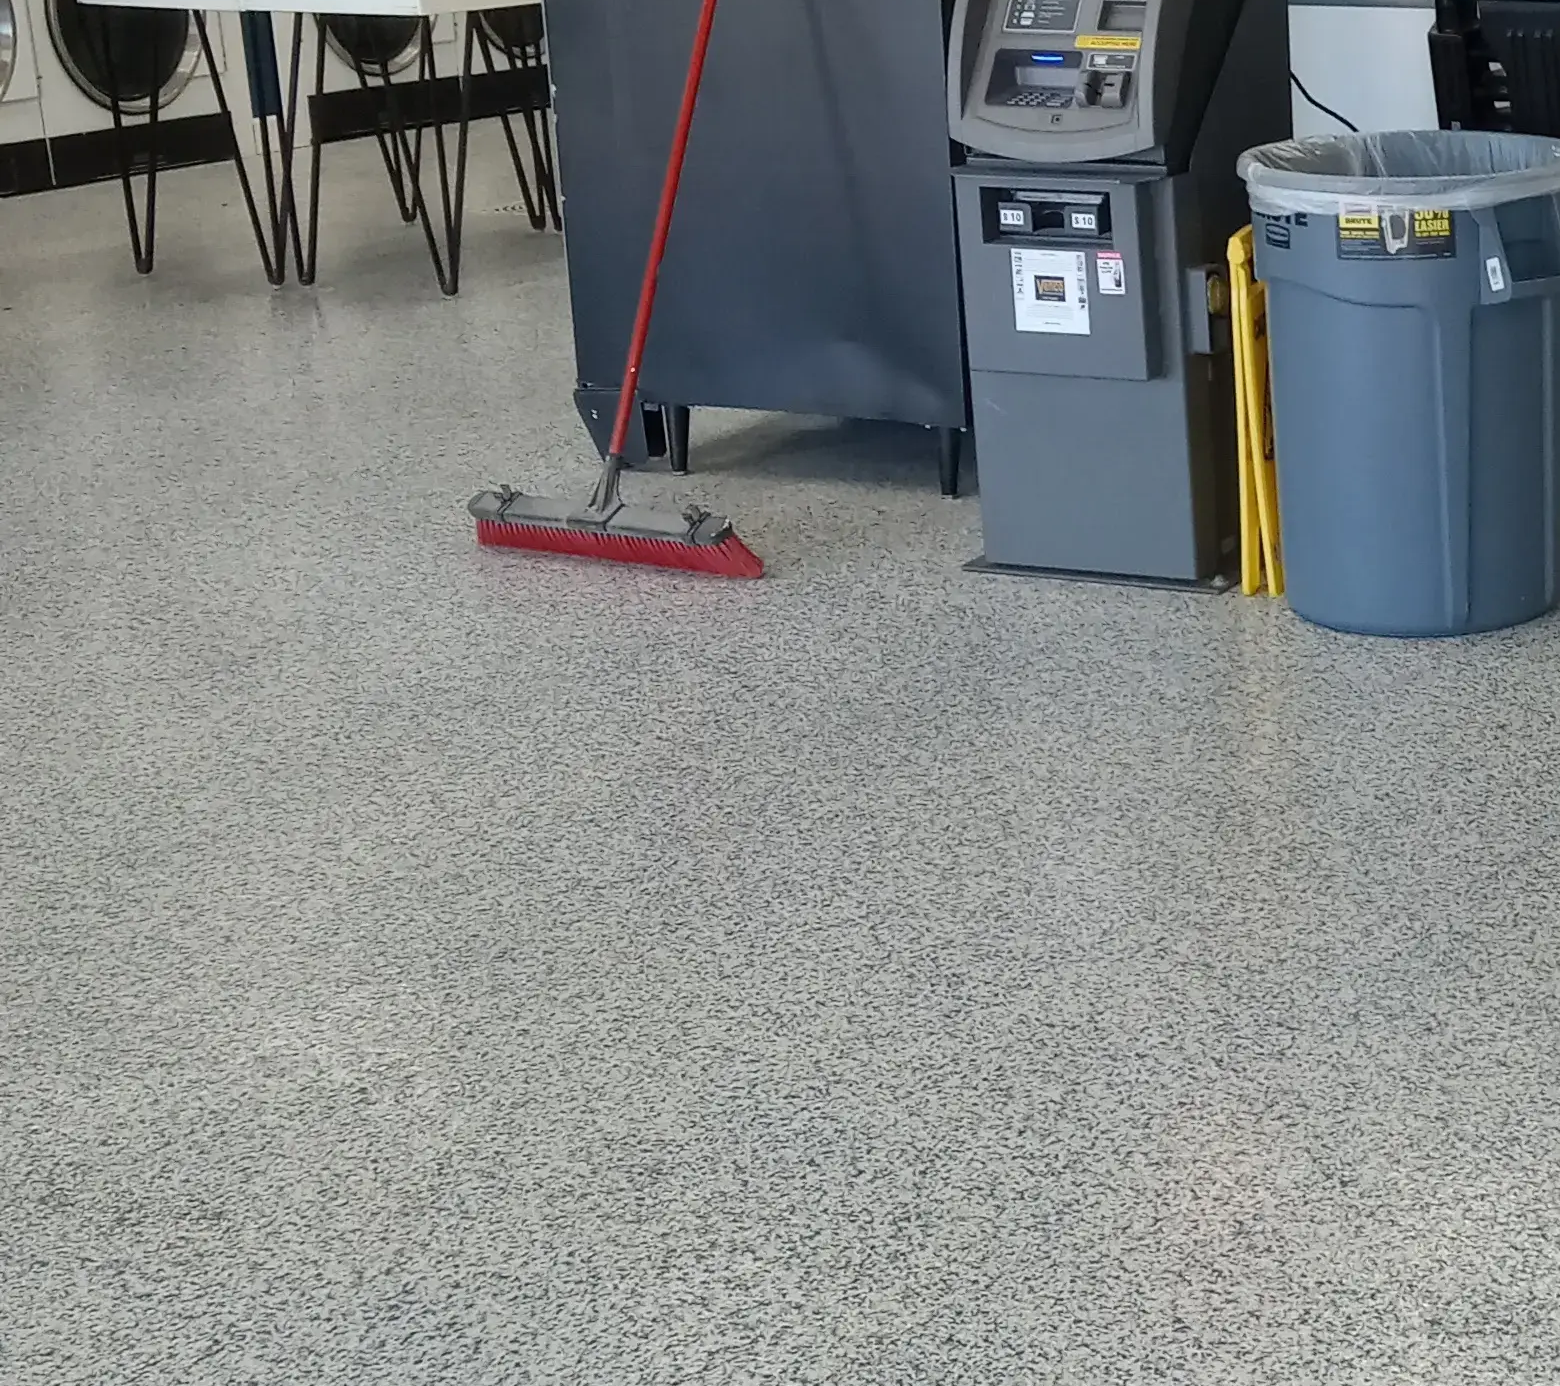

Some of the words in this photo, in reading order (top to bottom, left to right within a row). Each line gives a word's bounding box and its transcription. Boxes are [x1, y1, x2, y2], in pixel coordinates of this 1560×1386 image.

[1010, 212, 1022, 222] 10
[1082, 216, 1093, 225] 10
[1414, 219, 1450, 231] EASIER
